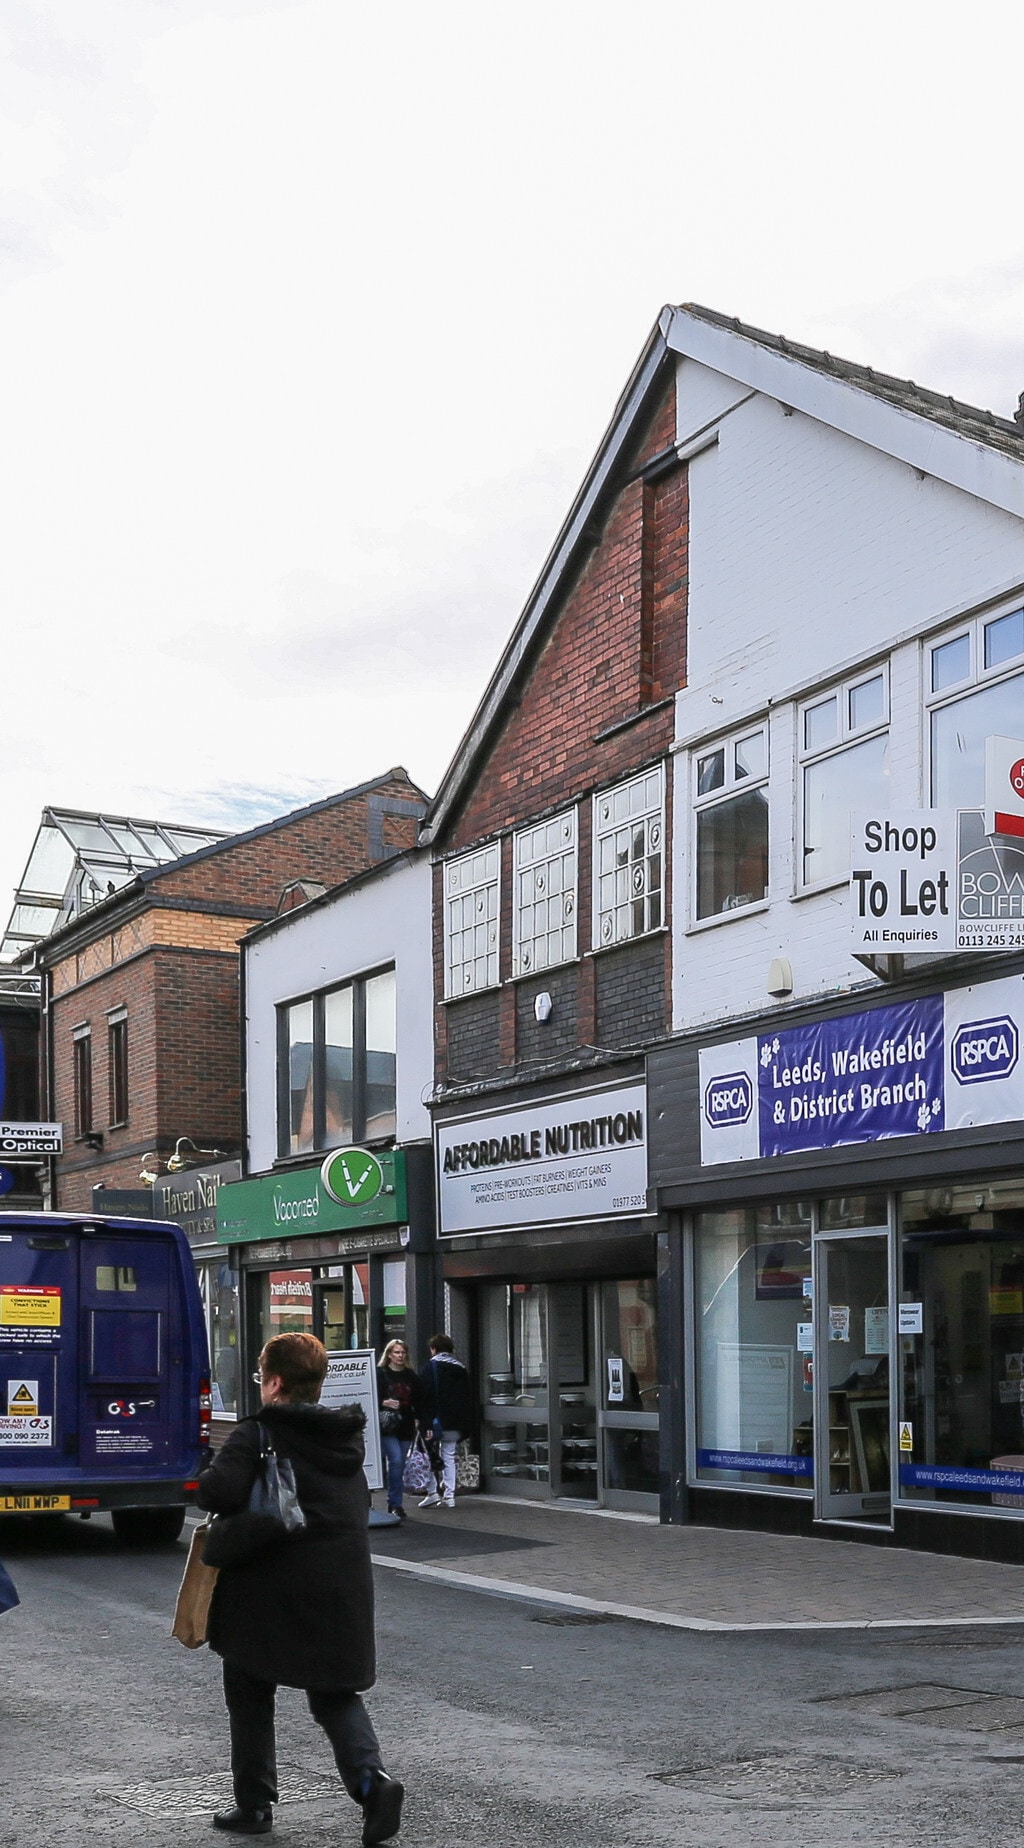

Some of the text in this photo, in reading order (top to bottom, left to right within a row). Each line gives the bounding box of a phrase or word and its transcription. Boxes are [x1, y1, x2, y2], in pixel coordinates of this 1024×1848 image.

[864, 821, 937, 860] Shop
[852, 869, 949, 918] To Let
[863, 929, 938, 944] All Enquiries
[958, 935, 984, 946] 0113
[987, 935, 1006, 946] 245
[959, 923, 1015, 933] BOWCLIFFE
[772, 1032, 927, 1089] Leeds, Wakefield
[959, 1034, 1011, 1067] RSPCA
[710, 1087, 747, 1113] RSPCA
[773, 1072, 927, 1125] & District Branch
[1, 1126, 58, 1137] Premier
[442, 1109, 644, 1175] AFFORDABLE NUTRITION
[2, 1139, 58, 1153] Optical
[470, 1163, 612, 1194] PROTEINS PRE-WORKOUTS FAT BURNERS WEIGHT GAINERS
[474, 1191, 490, 1204] AMINO
[490, 1190, 505, 1202] ACIDS
[506, 1188, 518, 1200] TEST
[518, 1185, 545, 1199] BOOSTERS
[547, 1181, 574, 1195] CREATINES
[576, 1179, 588, 1191] VITS
[593, 1176, 607, 1188] MINS
[162, 1185, 195, 1217] Haven
[273, 1183, 320, 1225] Vaporized
[612, 1196, 630, 1208] 01977
[630, 1195, 641, 1206] 520
[14, 1432, 29, 1440] 090
[30, 1432, 50, 1440] 2372
[33, 1495, 60, 1509] WWP
